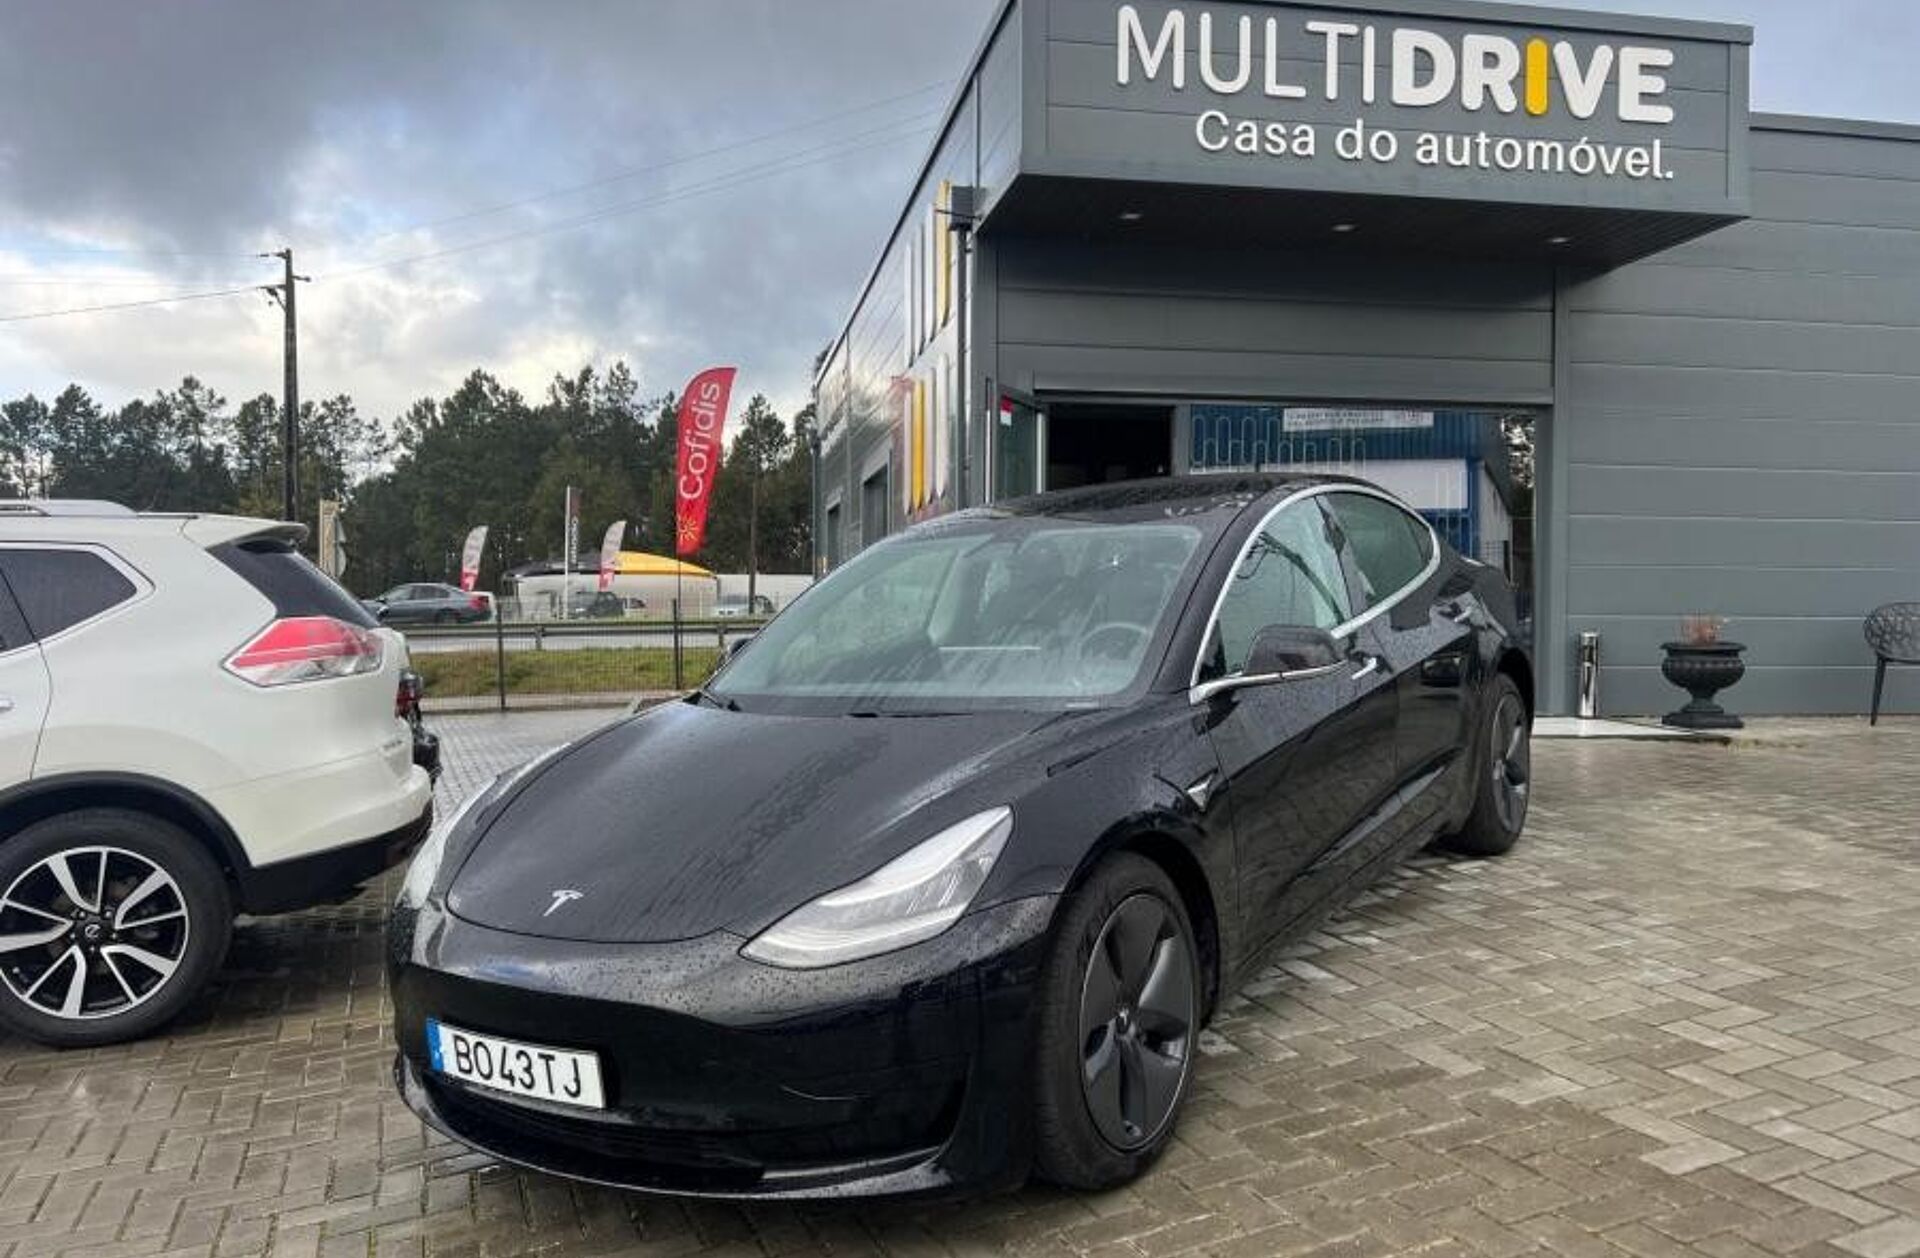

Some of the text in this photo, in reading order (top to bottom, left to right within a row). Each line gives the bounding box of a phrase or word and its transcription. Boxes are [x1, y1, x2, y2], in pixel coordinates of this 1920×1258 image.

[1117, 6, 1674, 123] MULTIDRIVE
[1196, 110, 1674, 180] Casa do automóvel.
[681, 382, 720, 499] Cofidis
